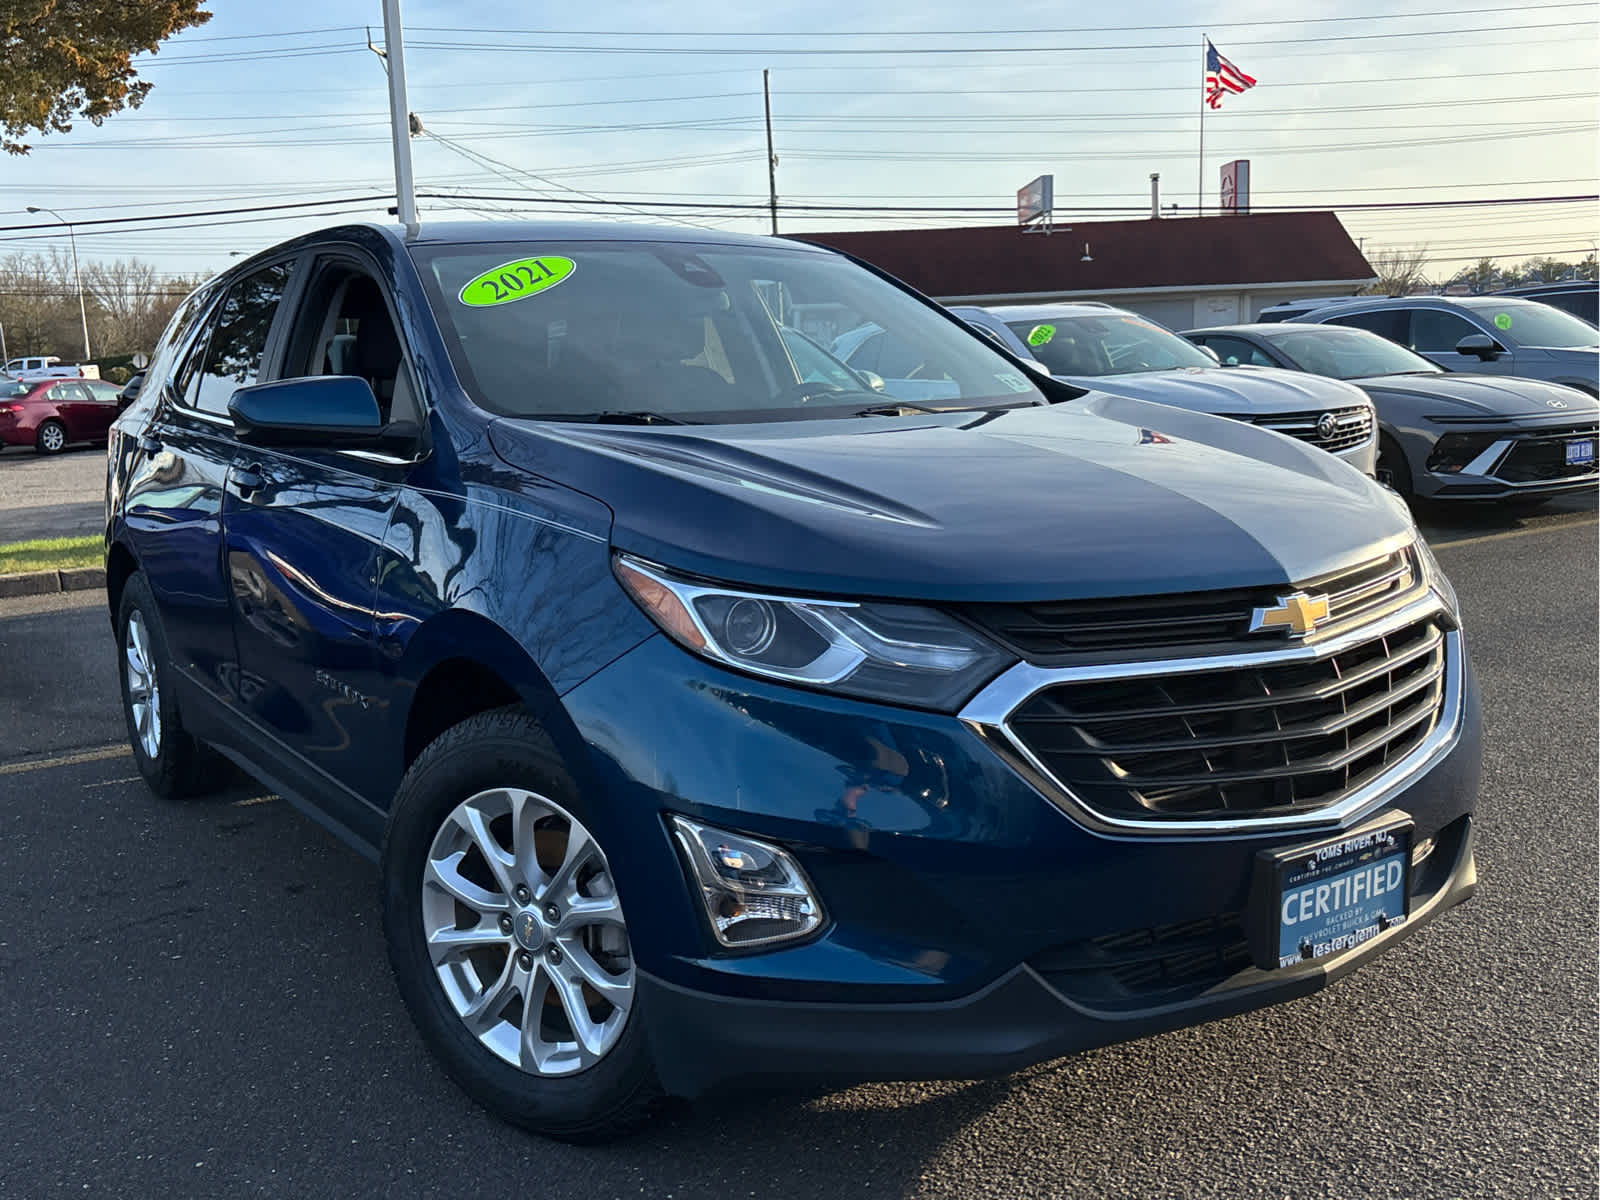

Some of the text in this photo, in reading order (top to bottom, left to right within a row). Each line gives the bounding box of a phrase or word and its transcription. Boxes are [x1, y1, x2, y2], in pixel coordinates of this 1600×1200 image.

[481, 260, 557, 301] 2021
[1314, 845, 1343, 863] TOMS
[1375, 830, 1387, 844] NJ
[1281, 859, 1403, 926] CERTIFIED
[1326, 906, 1364, 926] BACKED BY
